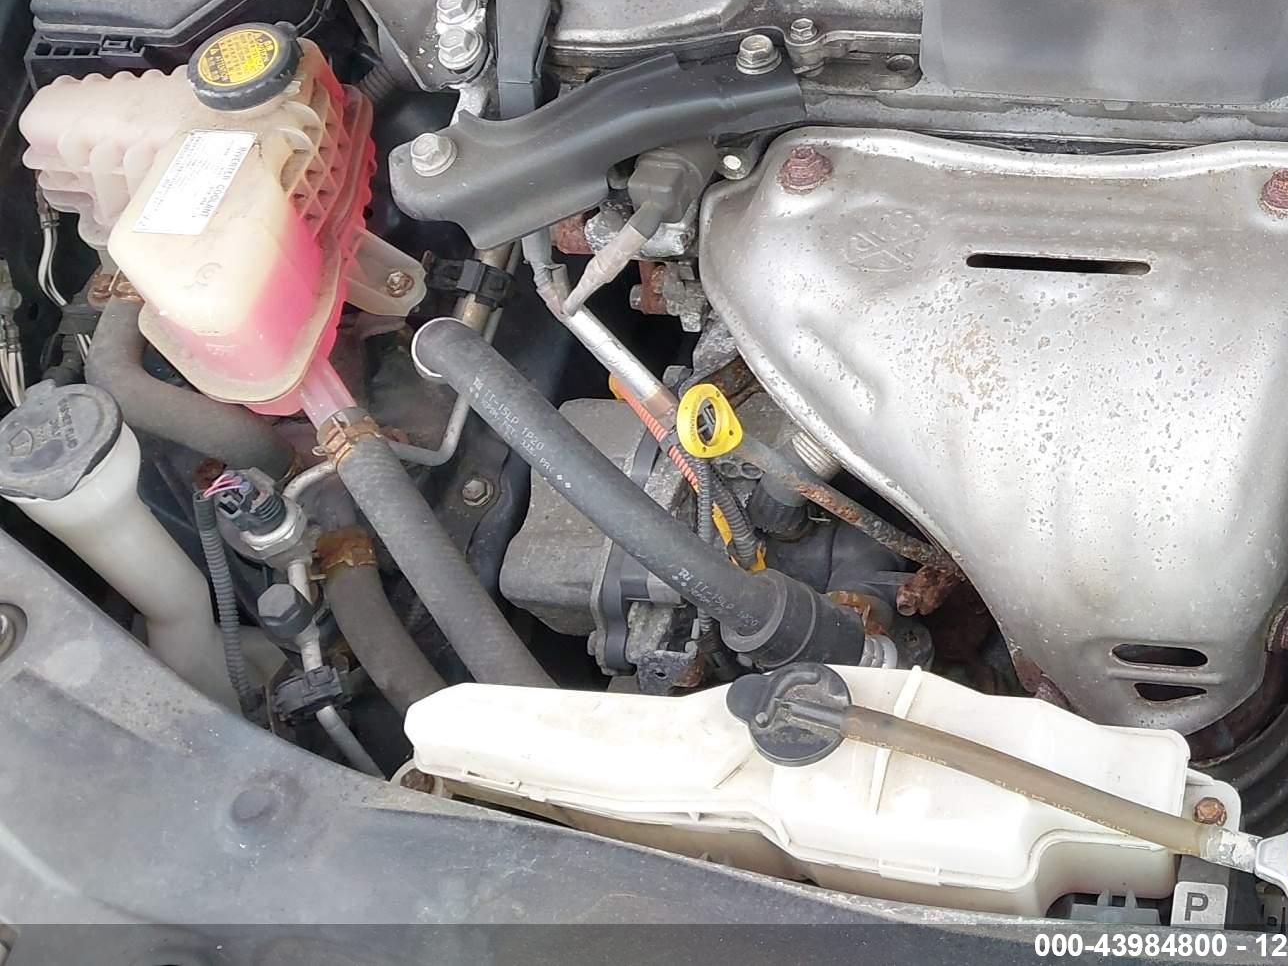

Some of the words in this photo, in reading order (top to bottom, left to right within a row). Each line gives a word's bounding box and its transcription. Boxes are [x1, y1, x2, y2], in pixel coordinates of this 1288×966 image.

[221, 146, 248, 180] INVERTER
[200, 183, 225, 217] COOLANT
[1184, 892, 1209, 922] P
